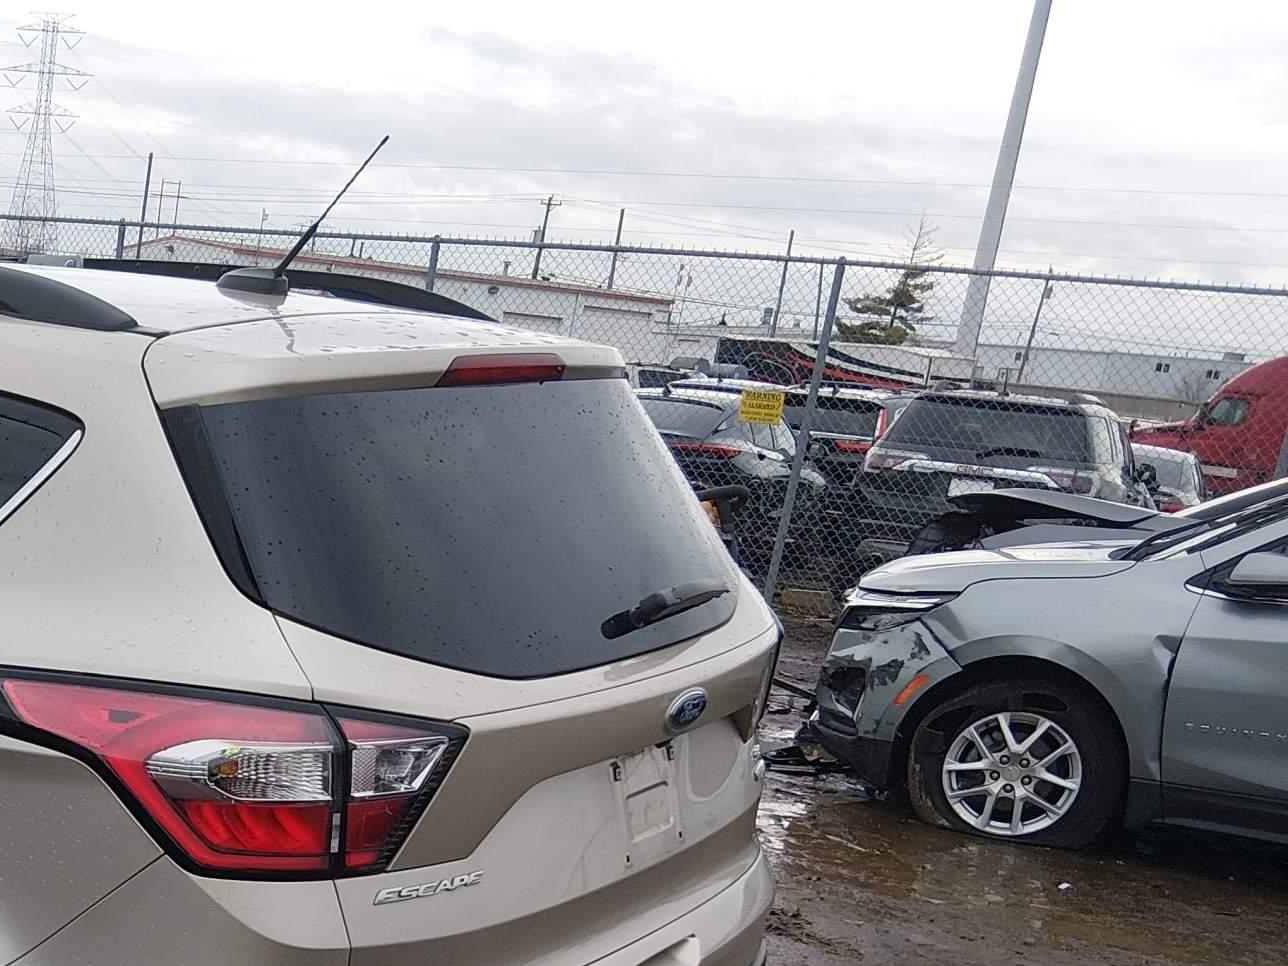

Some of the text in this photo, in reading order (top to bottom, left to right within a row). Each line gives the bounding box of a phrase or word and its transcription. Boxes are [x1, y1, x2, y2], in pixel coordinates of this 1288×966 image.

[745, 391, 782, 402] WARNING
[956, 464, 994, 476] GMC
[373, 871, 484, 905] ESCAPE
